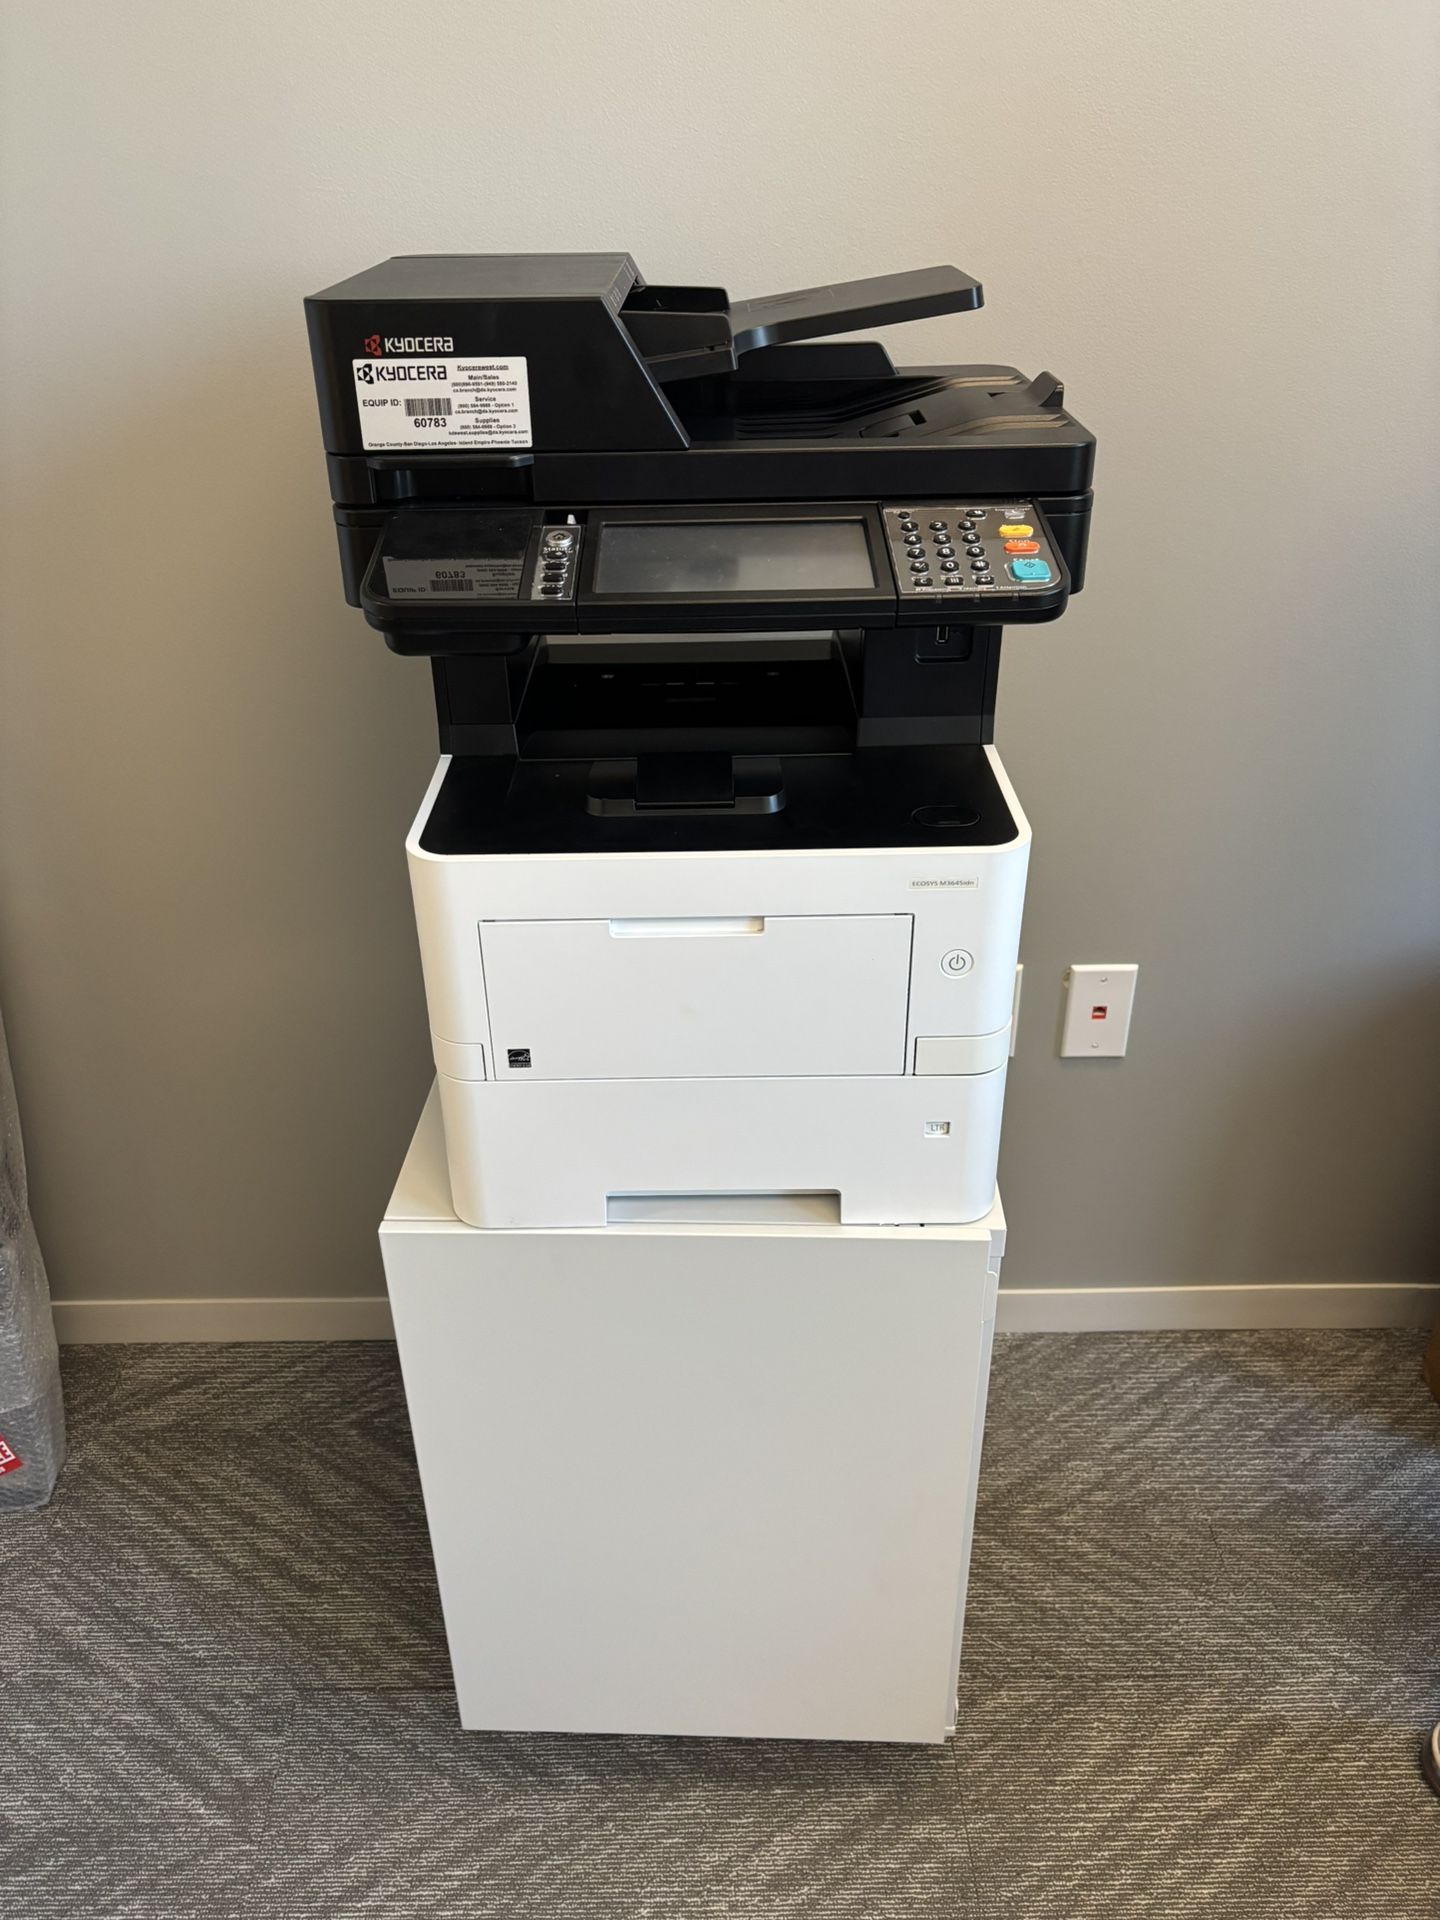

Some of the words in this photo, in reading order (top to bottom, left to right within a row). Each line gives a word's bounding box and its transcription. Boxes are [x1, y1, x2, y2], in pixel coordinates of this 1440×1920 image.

[384, 337, 454, 353] KYOCERA
[376, 365, 447, 381] KYOCERA
[390, 399, 402, 407] ID:
[414, 418, 447, 428] 60783
